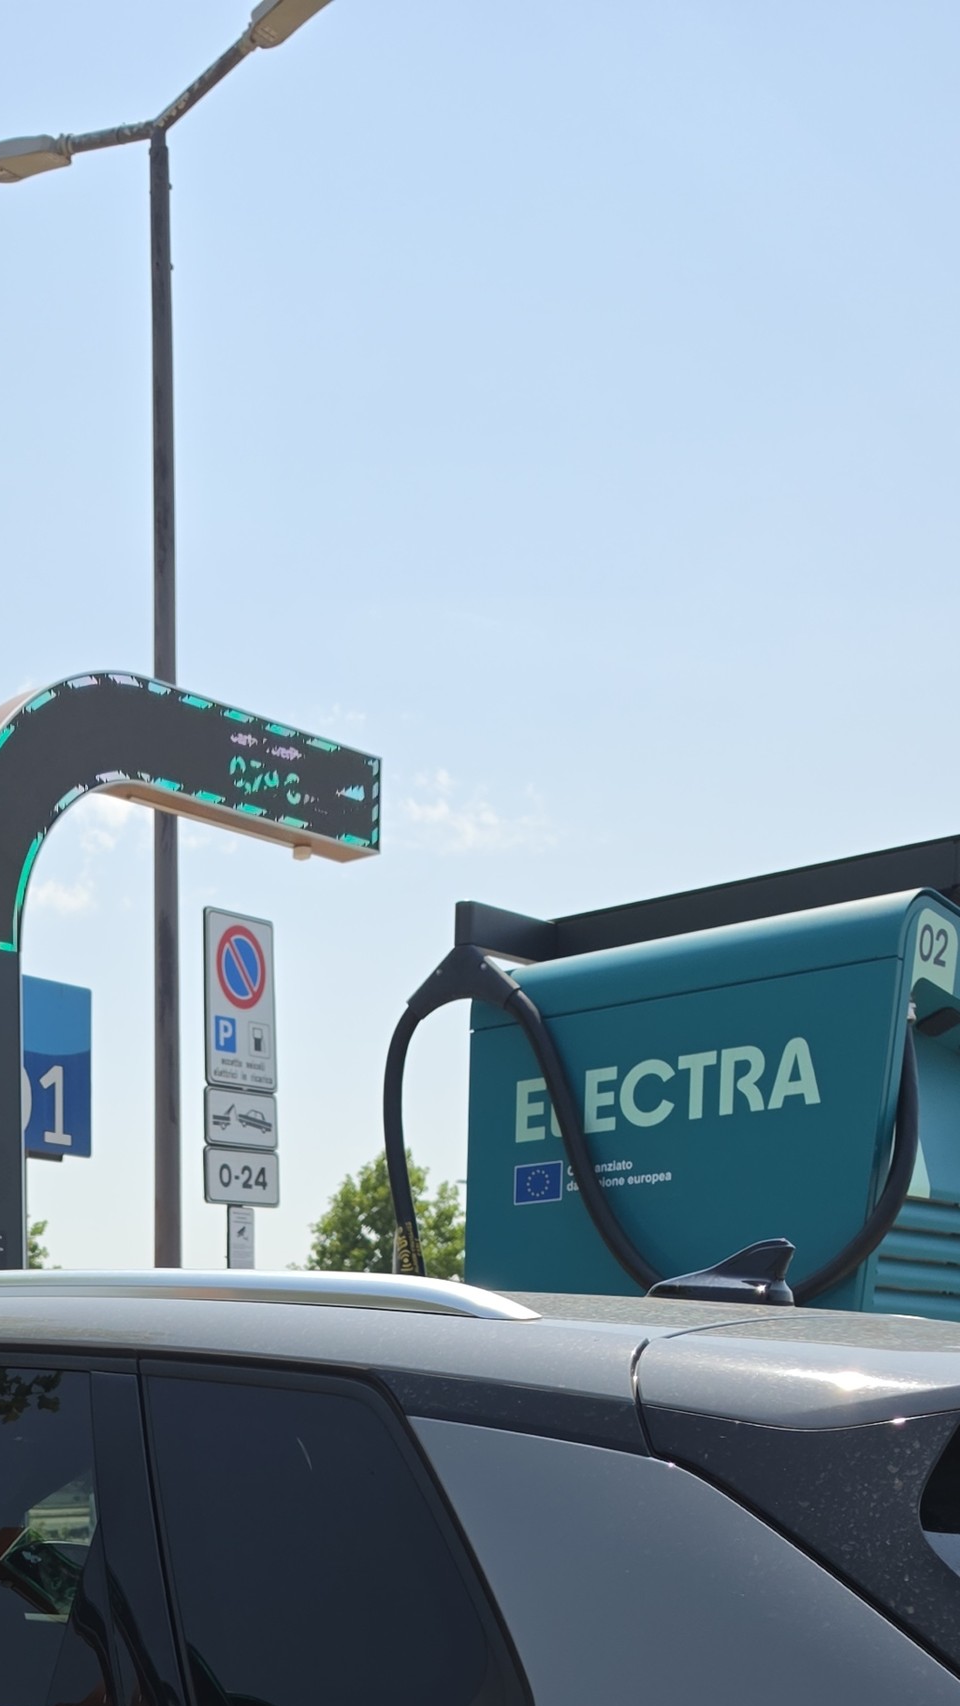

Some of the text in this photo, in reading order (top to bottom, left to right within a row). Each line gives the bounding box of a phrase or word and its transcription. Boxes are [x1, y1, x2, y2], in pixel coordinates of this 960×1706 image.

[919, 923, 949, 968] 02
[219, 1019, 233, 1047] P
[23, 1064, 72, 1146] 1
[219, 1163, 268, 1191] 0-24
[566, 1171, 672, 1192] daione europea
[567, 1160, 633, 1177] Canziato
